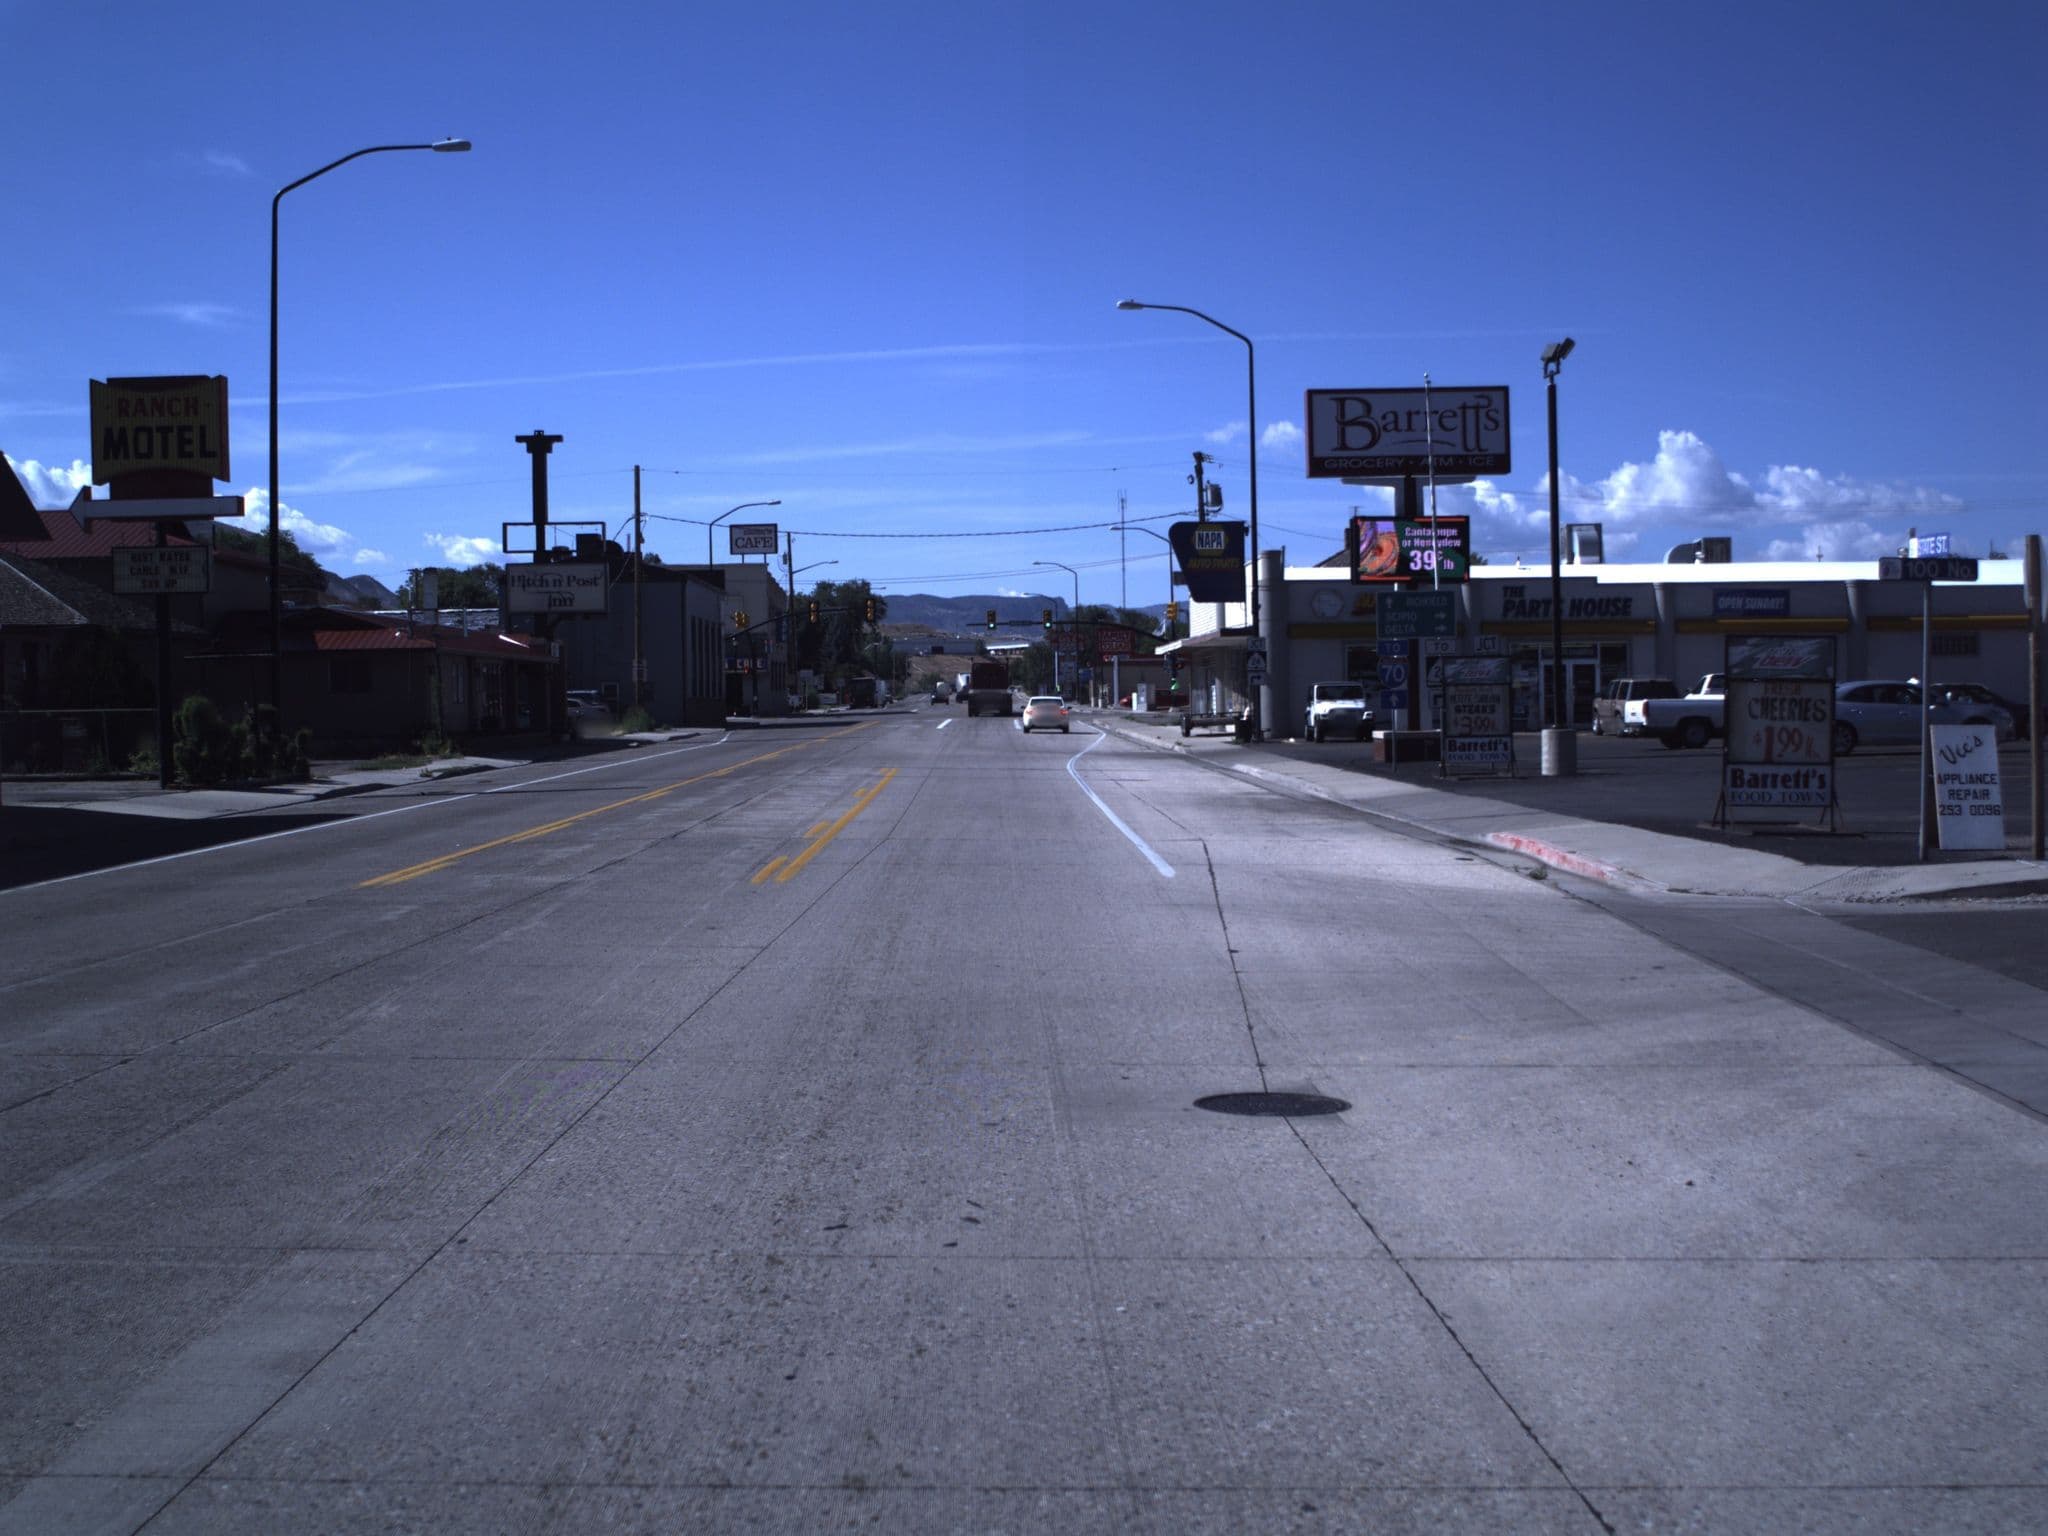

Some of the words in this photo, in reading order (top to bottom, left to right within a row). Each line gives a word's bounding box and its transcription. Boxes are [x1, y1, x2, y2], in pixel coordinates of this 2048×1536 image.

[117, 396, 199, 417] RANCH
[1329, 395, 1500, 452] Barrett's
[103, 425, 217, 461] MOTEL
[1324, 456, 1405, 470] GROCERY
[1468, 455, 1497, 467] ICE
[735, 536, 773, 549] CAFE
[1198, 532, 1223, 548] NAPA
[1905, 560, 1938, 579] 100
[1502, 585, 1525, 598] THE
[1568, 599, 1633, 617] HOUSE
[1385, 642, 1401, 652] TO
[1434, 642, 1449, 651] TO
[1477, 637, 1497, 651] JCT
[1381, 664, 1406, 685] 70
[1448, 739, 1509, 753] Barrett's
[1731, 767, 1827, 790] Barrett's
[1937, 773, 1998, 785] APPLIANCE
[1730, 791, 1773, 803] FOOD
[1780, 790, 1826, 803] TOWN
[1948, 788, 1990, 800] REPAIR
[1939, 804, 1962, 816] 253
